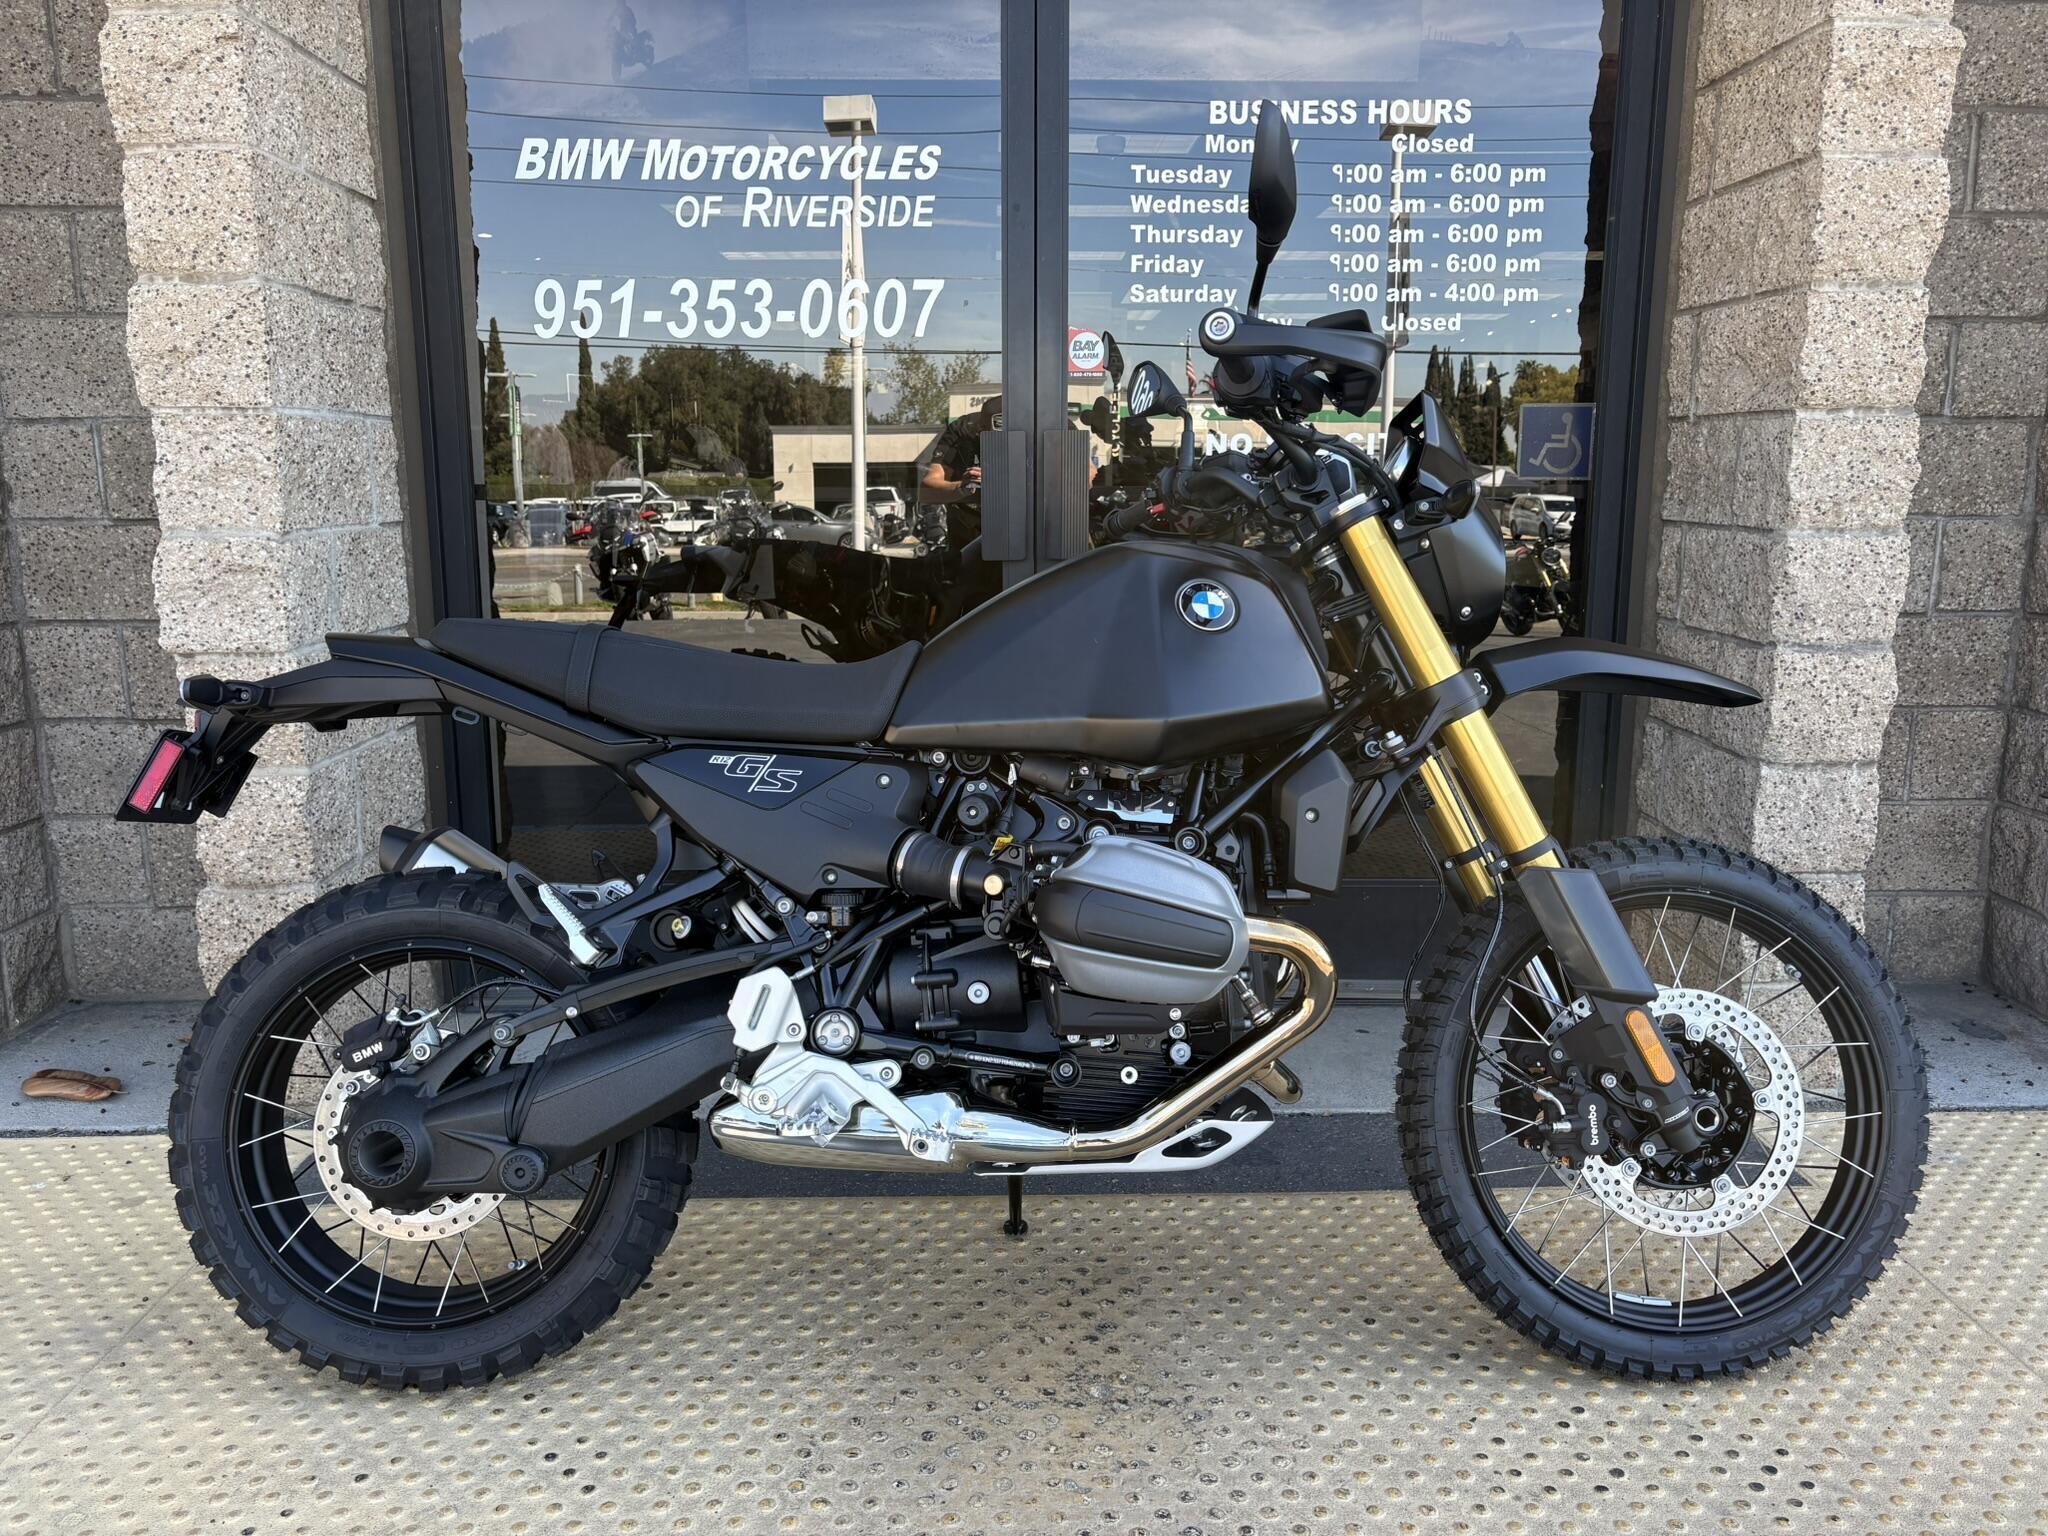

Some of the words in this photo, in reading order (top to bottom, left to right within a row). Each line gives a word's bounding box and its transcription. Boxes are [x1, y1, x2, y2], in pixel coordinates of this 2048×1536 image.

[1209, 98, 1358, 125] BUSNESS
[1368, 98, 1473, 124] HOURS
[1391, 133, 1474, 153] Closed
[514, 137, 634, 181] BMW
[640, 137, 942, 181] MOTORCYCLES
[1130, 164, 1232, 189] Tuesday
[1332, 164, 1383, 184] 9:00
[1390, 168, 1427, 184] am
[1450, 163, 1502, 184] 6:00
[1509, 168, 1546, 188] pm
[674, 194, 724, 229] OF
[742, 185, 936, 229] RIVERSIDE
[1130, 194, 1250, 215] Wednesda
[1331, 194, 1382, 214] 9:00
[1389, 198, 1426, 214] am
[1449, 193, 1500, 213] 6:00
[1507, 198, 1545, 218] pm
[1130, 223, 1244, 248] Thursday
[1330, 223, 1381, 243] 9:00
[1388, 228, 1424, 243] am
[1447, 223, 1499, 243] 6:00
[1506, 228, 1543, 248] pm
[1130, 254, 1204, 278] Friday
[1329, 253, 1379, 273] 9:00
[1387, 258, 1423, 273] am
[1446, 253, 1497, 273] 6:00
[1504, 257, 1541, 278] pm
[1129, 283, 1238, 308] Saturday
[1328, 283, 1378, 303] 9:00
[1386, 287, 1422, 302] am
[1444, 282, 1496, 302] 4:00
[1503, 287, 1539, 307] pm
[532, 277, 946, 340] 951-353-0607
[1381, 312, 1462, 331] Closed
[1072, 340, 1100, 352] BAY
[1072, 352, 1099, 360] ALARM
[1205, 433, 1253, 456] NO
[351, 1041, 384, 1063] BMW
[1587, 1104, 1600, 1146] brembo
